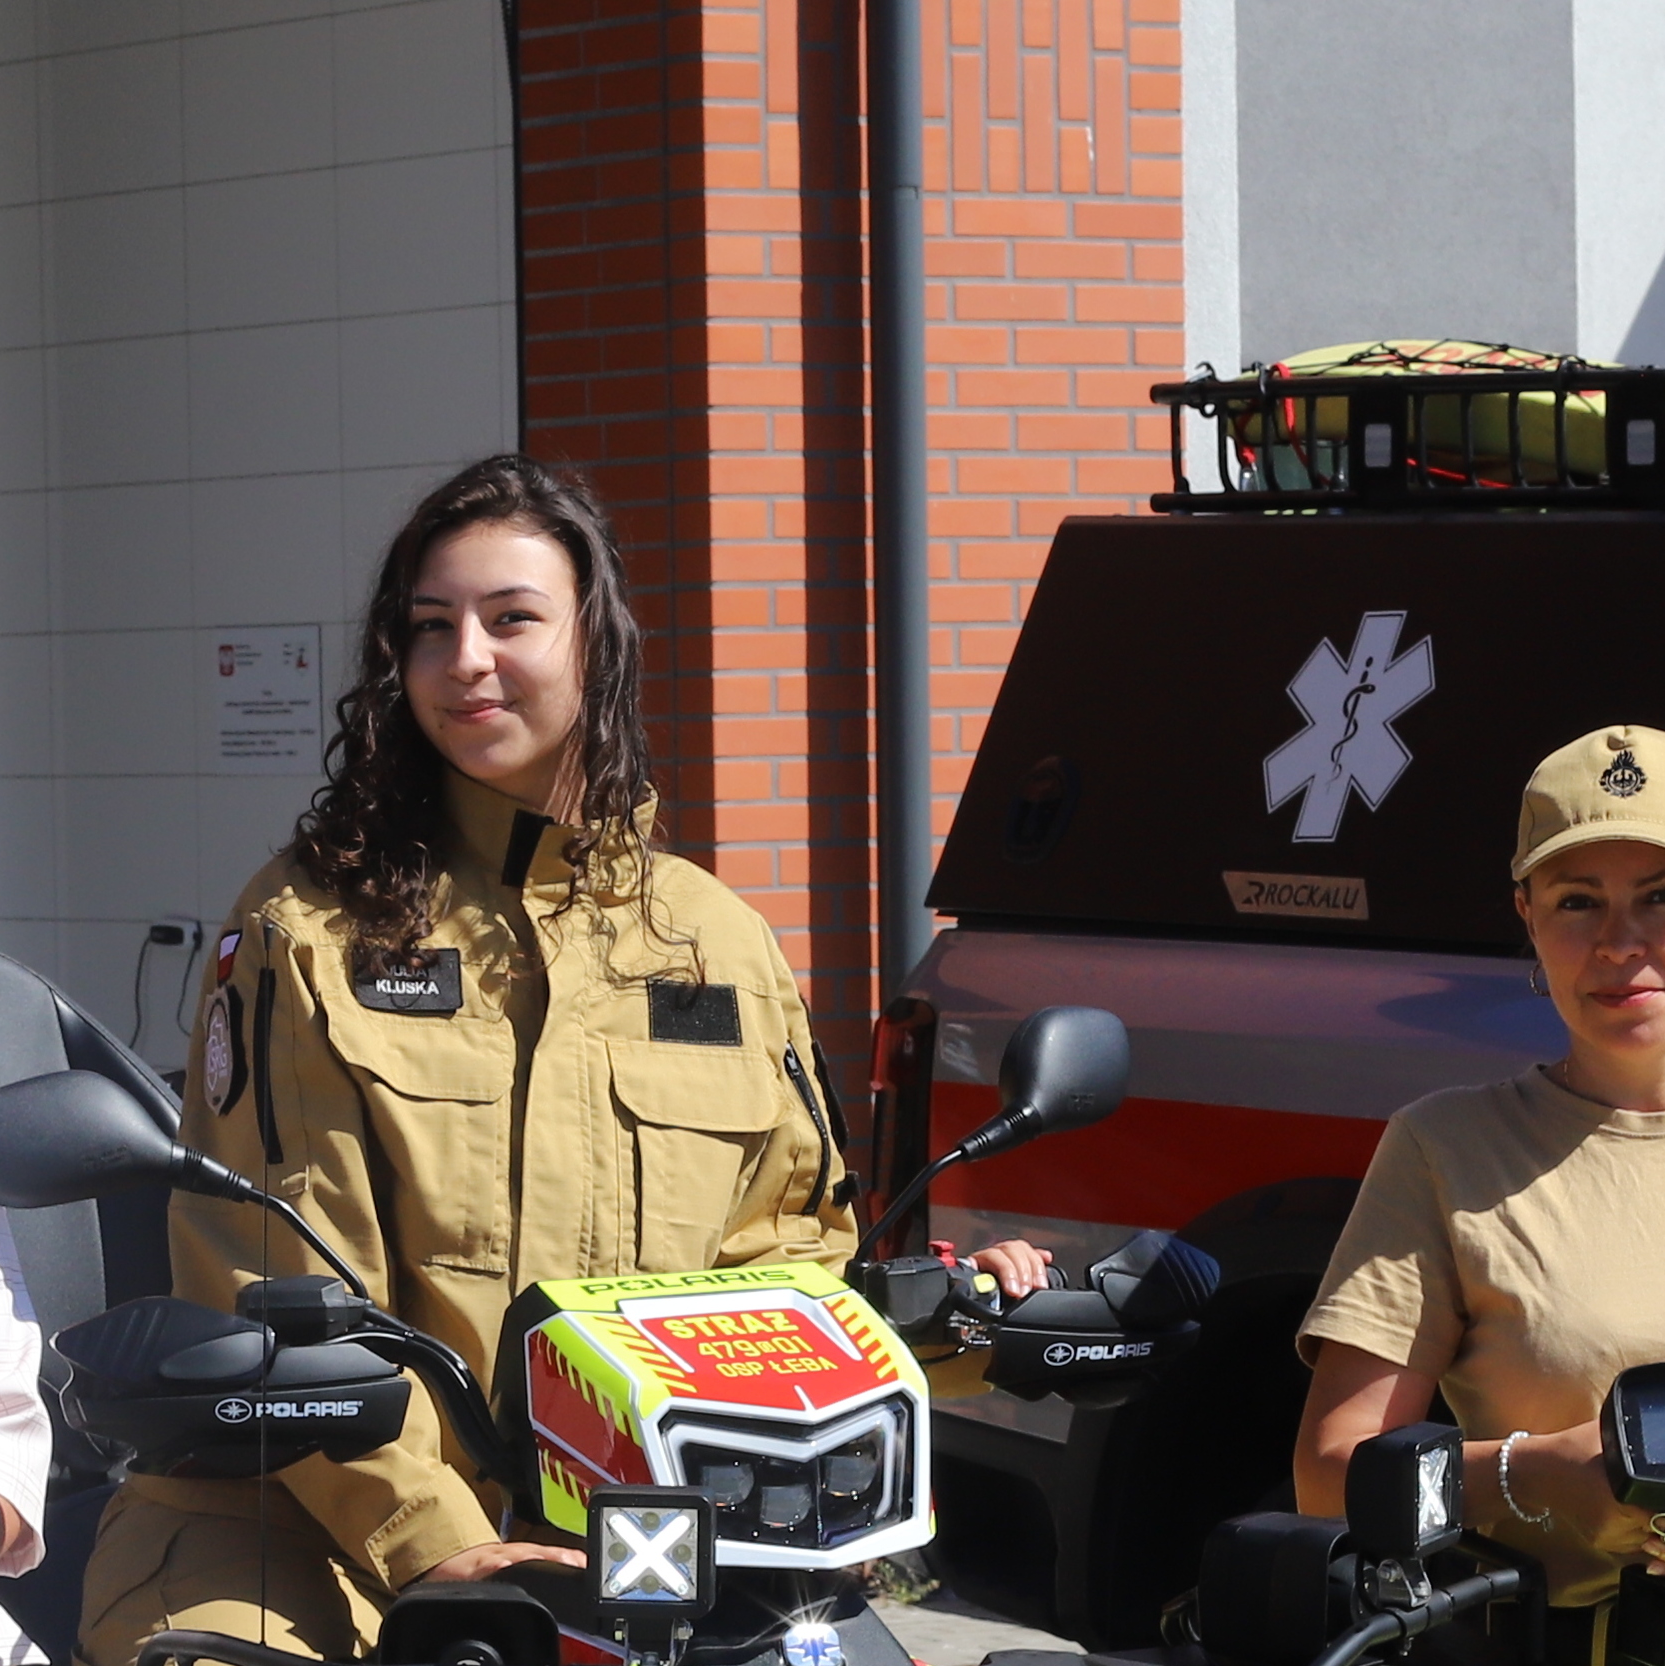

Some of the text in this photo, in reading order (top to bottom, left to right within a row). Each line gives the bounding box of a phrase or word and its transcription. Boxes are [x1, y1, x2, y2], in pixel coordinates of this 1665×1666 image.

[1264, 883, 1359, 910] ROCKALU
[376, 980, 439, 995] KLUSKA
[579, 1269, 796, 1295] POLARIS
[662, 1311, 800, 1339] STRAŻ
[1075, 1342, 1154, 1361] POLARIS
[715, 1356, 838, 1378] OSP ŁEBA
[255, 1400, 362, 1419] POLARIS
